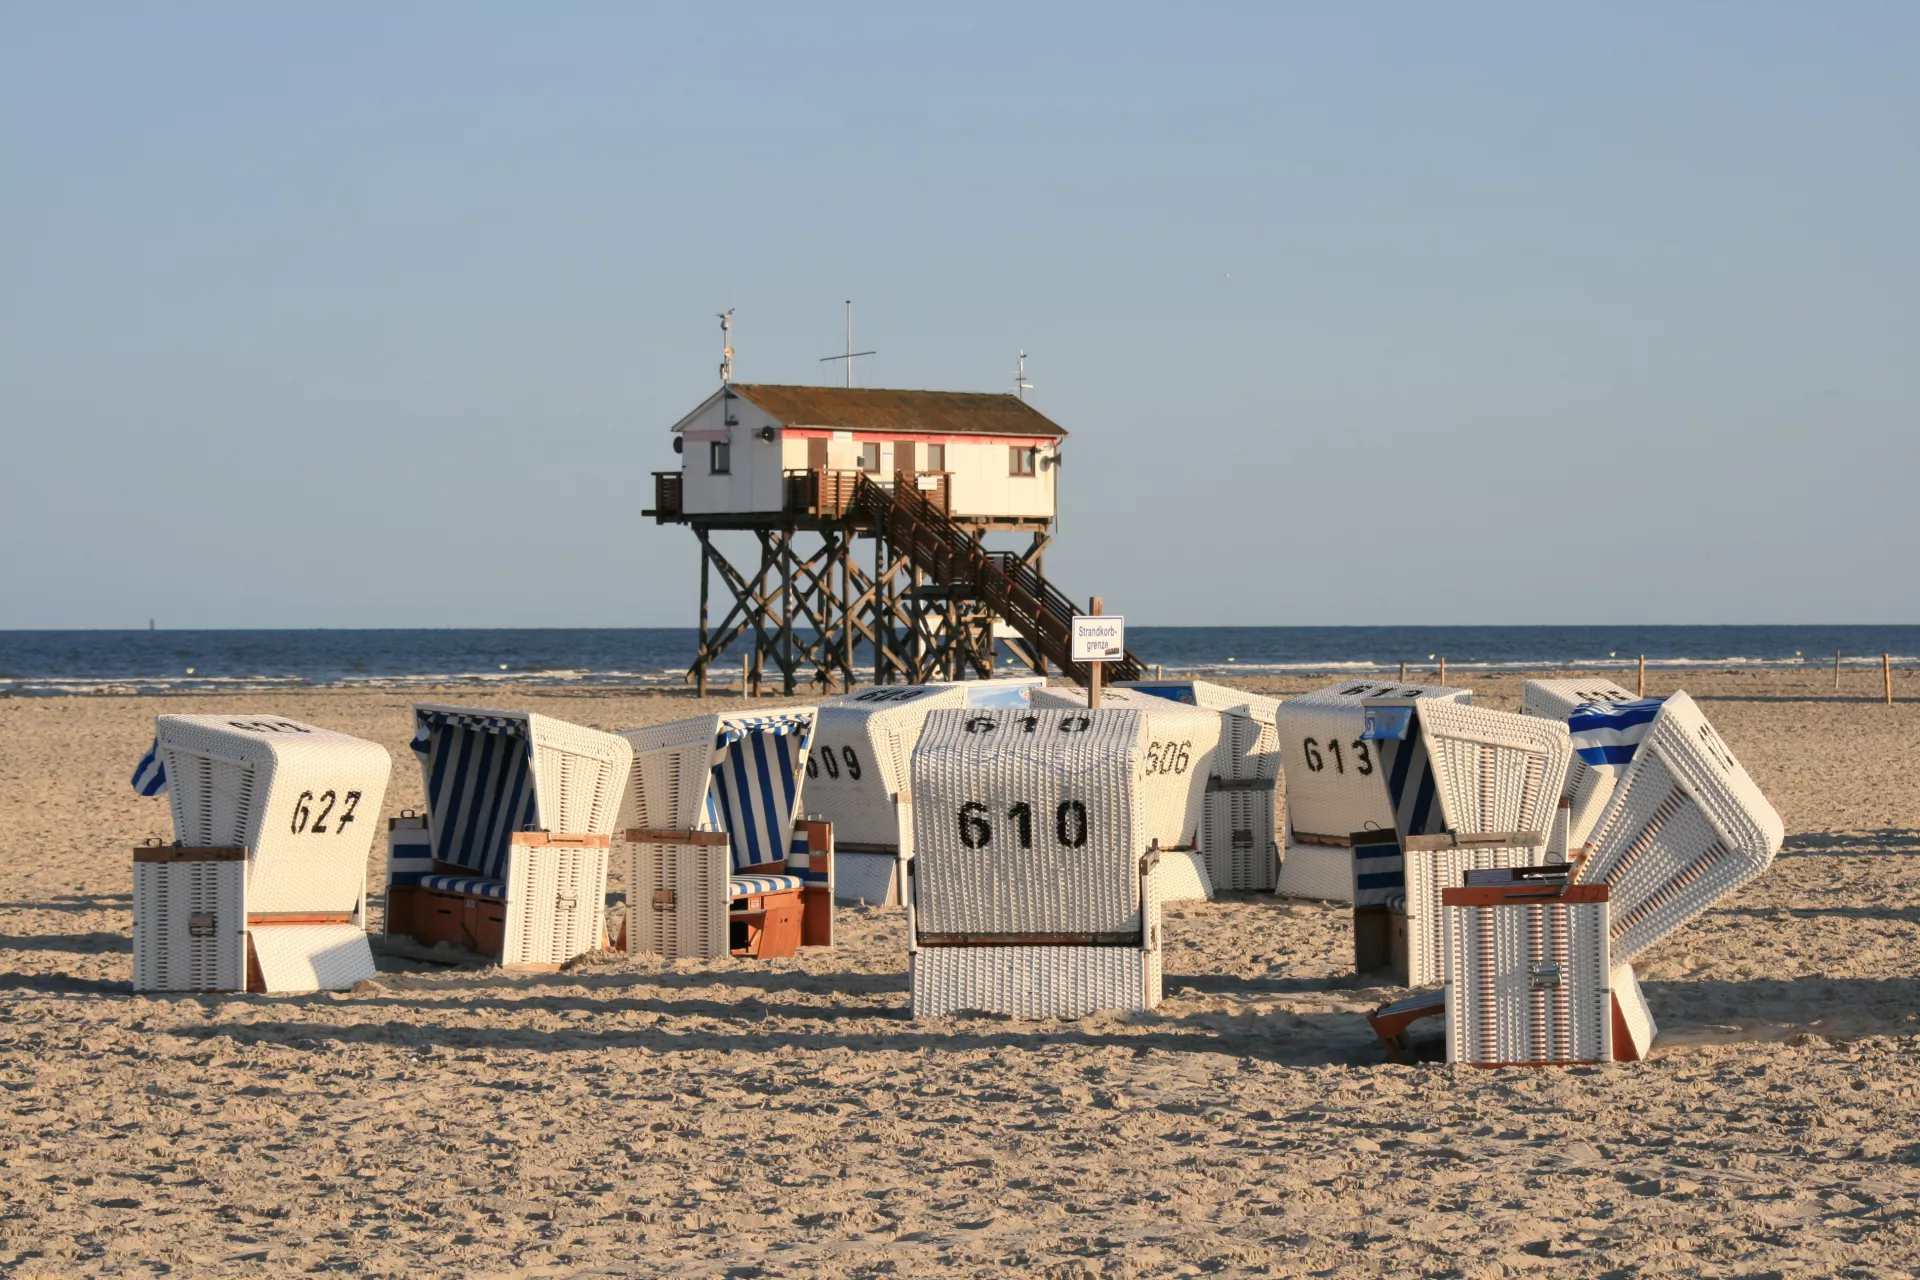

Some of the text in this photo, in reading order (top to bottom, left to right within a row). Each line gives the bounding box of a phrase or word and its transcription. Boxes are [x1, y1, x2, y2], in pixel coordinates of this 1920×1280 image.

[1078, 625, 1118, 637] Strandkorb-
[1086, 641, 1109, 653] grenze
[964, 715, 1092, 734] 610
[1145, 739, 1192, 776] 606
[1303, 736, 1373, 776] 613
[291, 789, 363, 836] 627
[957, 800, 1089, 850] 610
